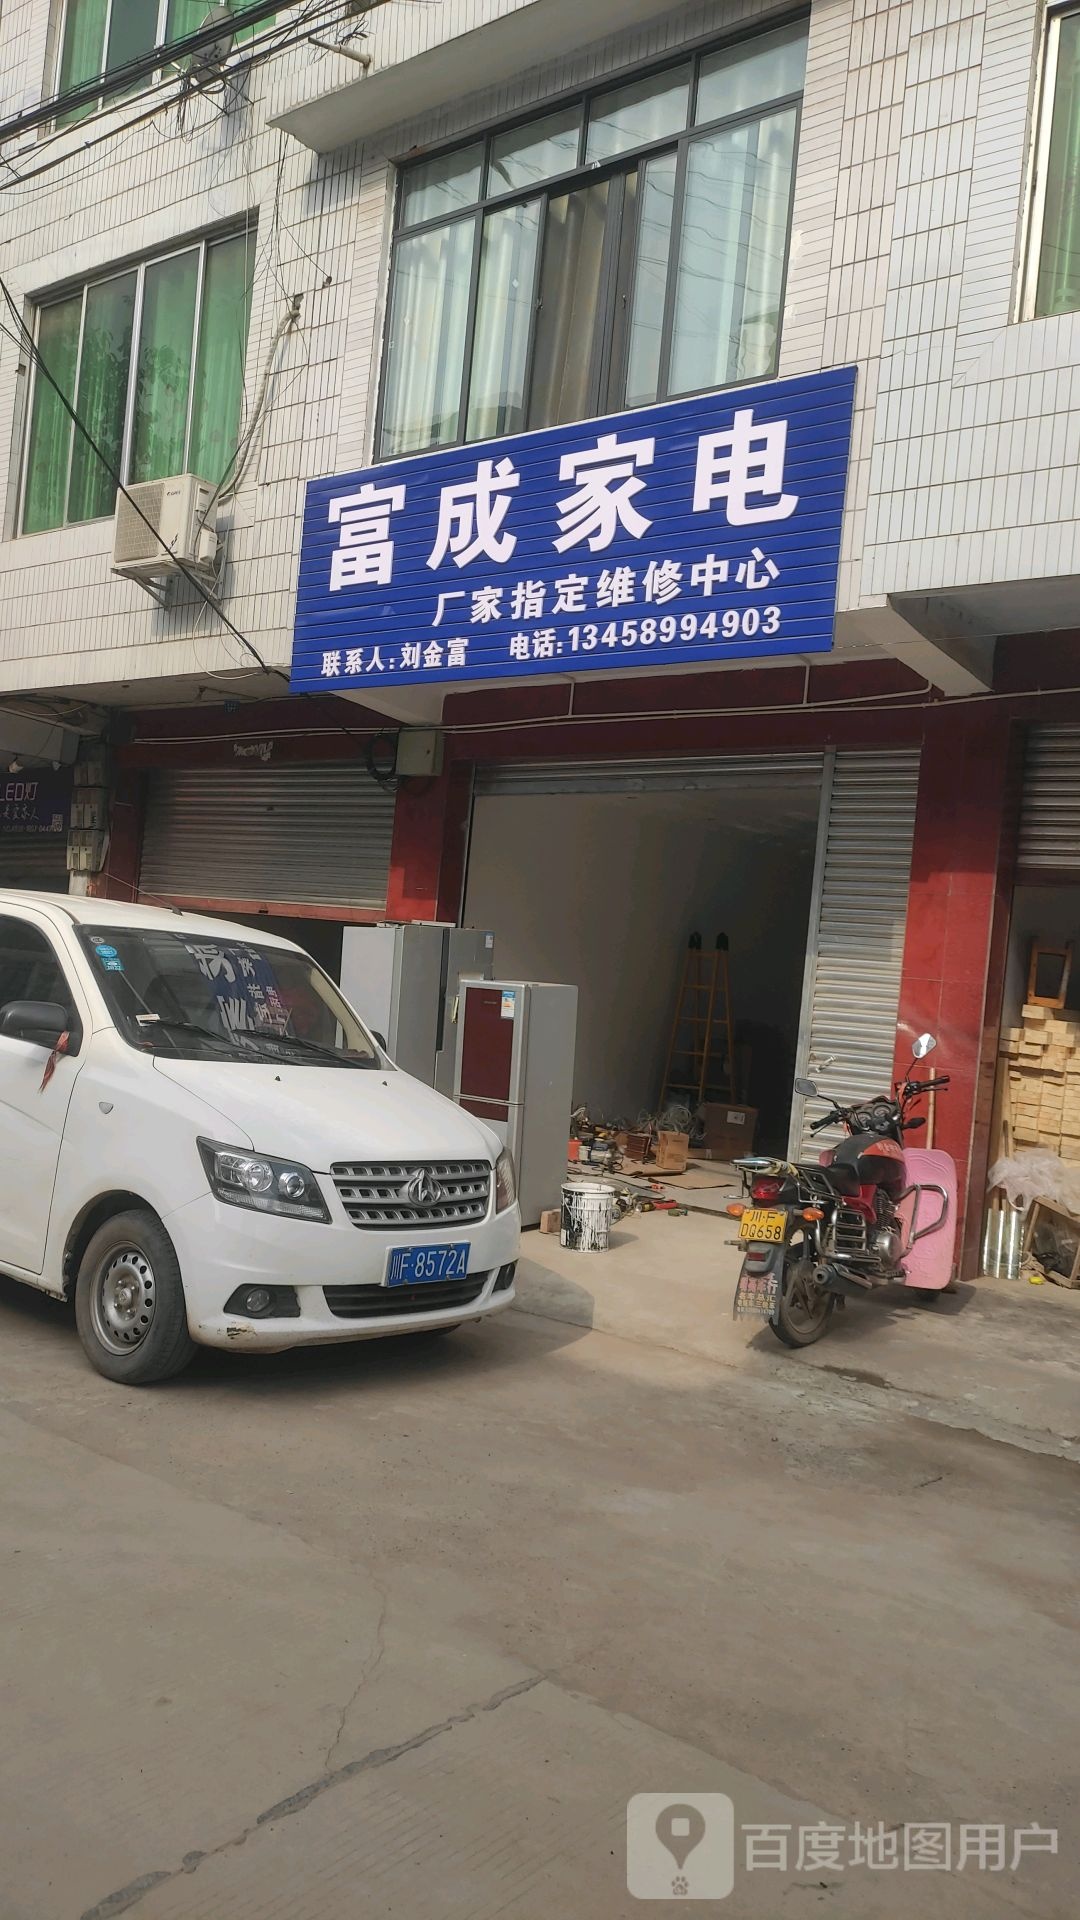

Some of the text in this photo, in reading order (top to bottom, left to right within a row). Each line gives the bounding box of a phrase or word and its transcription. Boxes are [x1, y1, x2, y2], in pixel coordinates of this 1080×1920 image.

[328, 409, 800, 592] 富成家电
[431, 546, 780, 627] 厂家指定维修中心
[740, 1223, 782, 1240] DQ658
